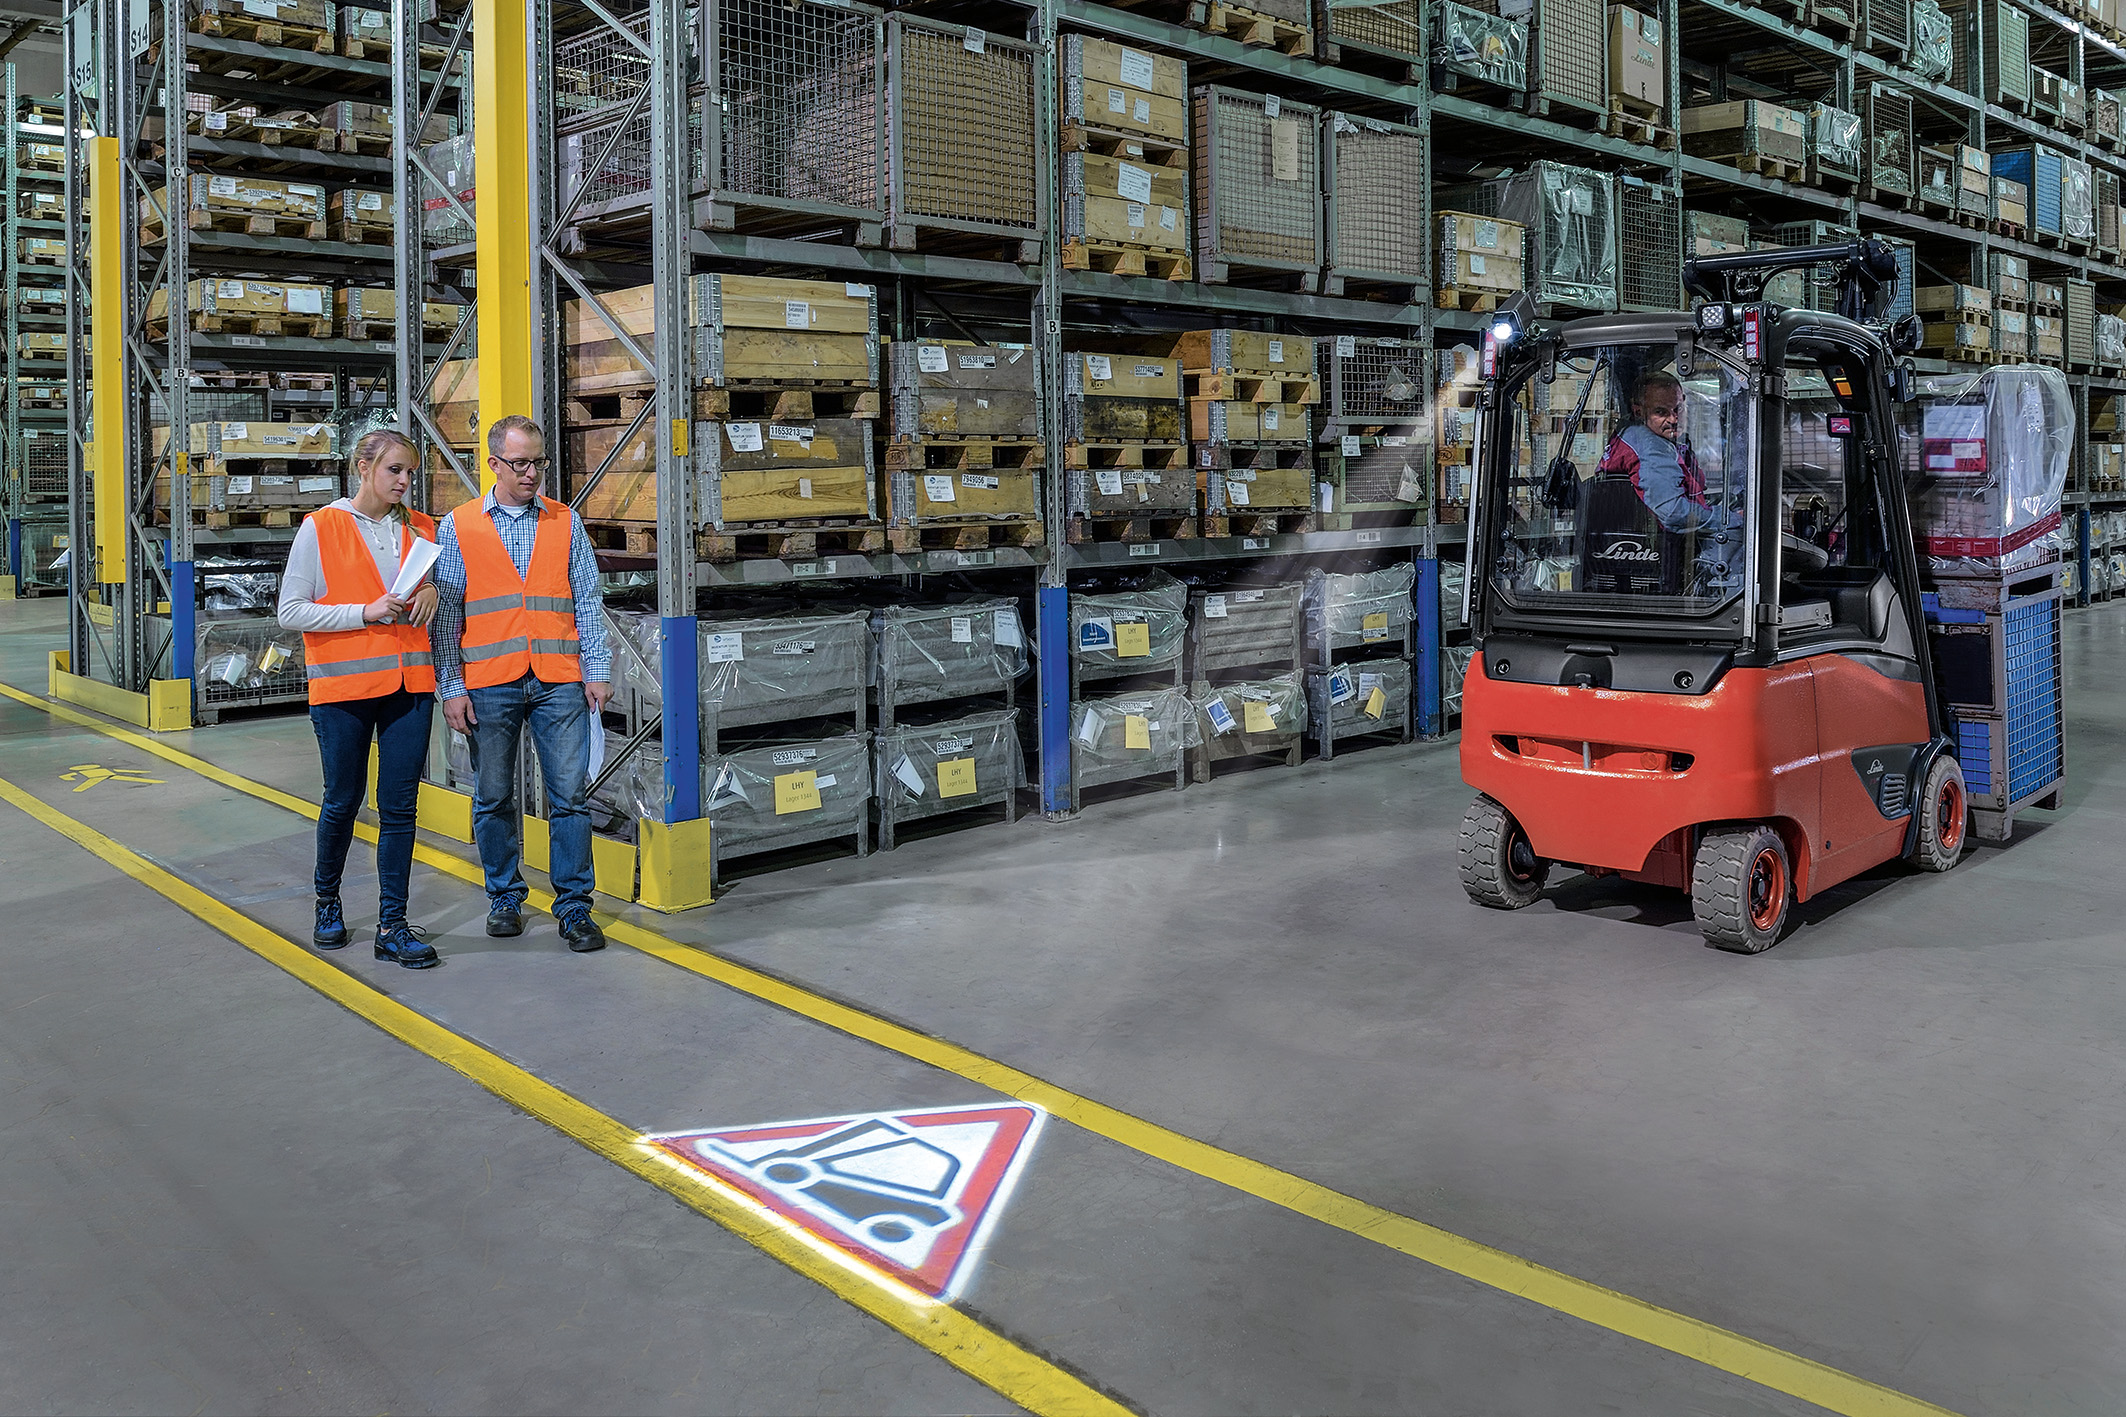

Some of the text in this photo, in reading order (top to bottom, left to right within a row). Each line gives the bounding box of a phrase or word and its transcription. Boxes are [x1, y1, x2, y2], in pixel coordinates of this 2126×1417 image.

[131, 23, 148, 52] S14
[1045, 40, 1052, 52] C
[76, 61, 92, 87] S15
[174, 167, 181, 177] C
[1049, 320, 1057, 332] B
[177, 369, 185, 377] B
[771, 426, 801, 436] 11653213
[1592, 541, 1660, 561] Linde
[773, 750, 803, 761] 52937376
[1867, 759, 1884, 774] Linde
[951, 768, 961, 777] LHY
[791, 781, 804, 791] LHY
[946, 778, 968, 789] Lager 1344
[785, 792, 812, 803] Lager 1344
